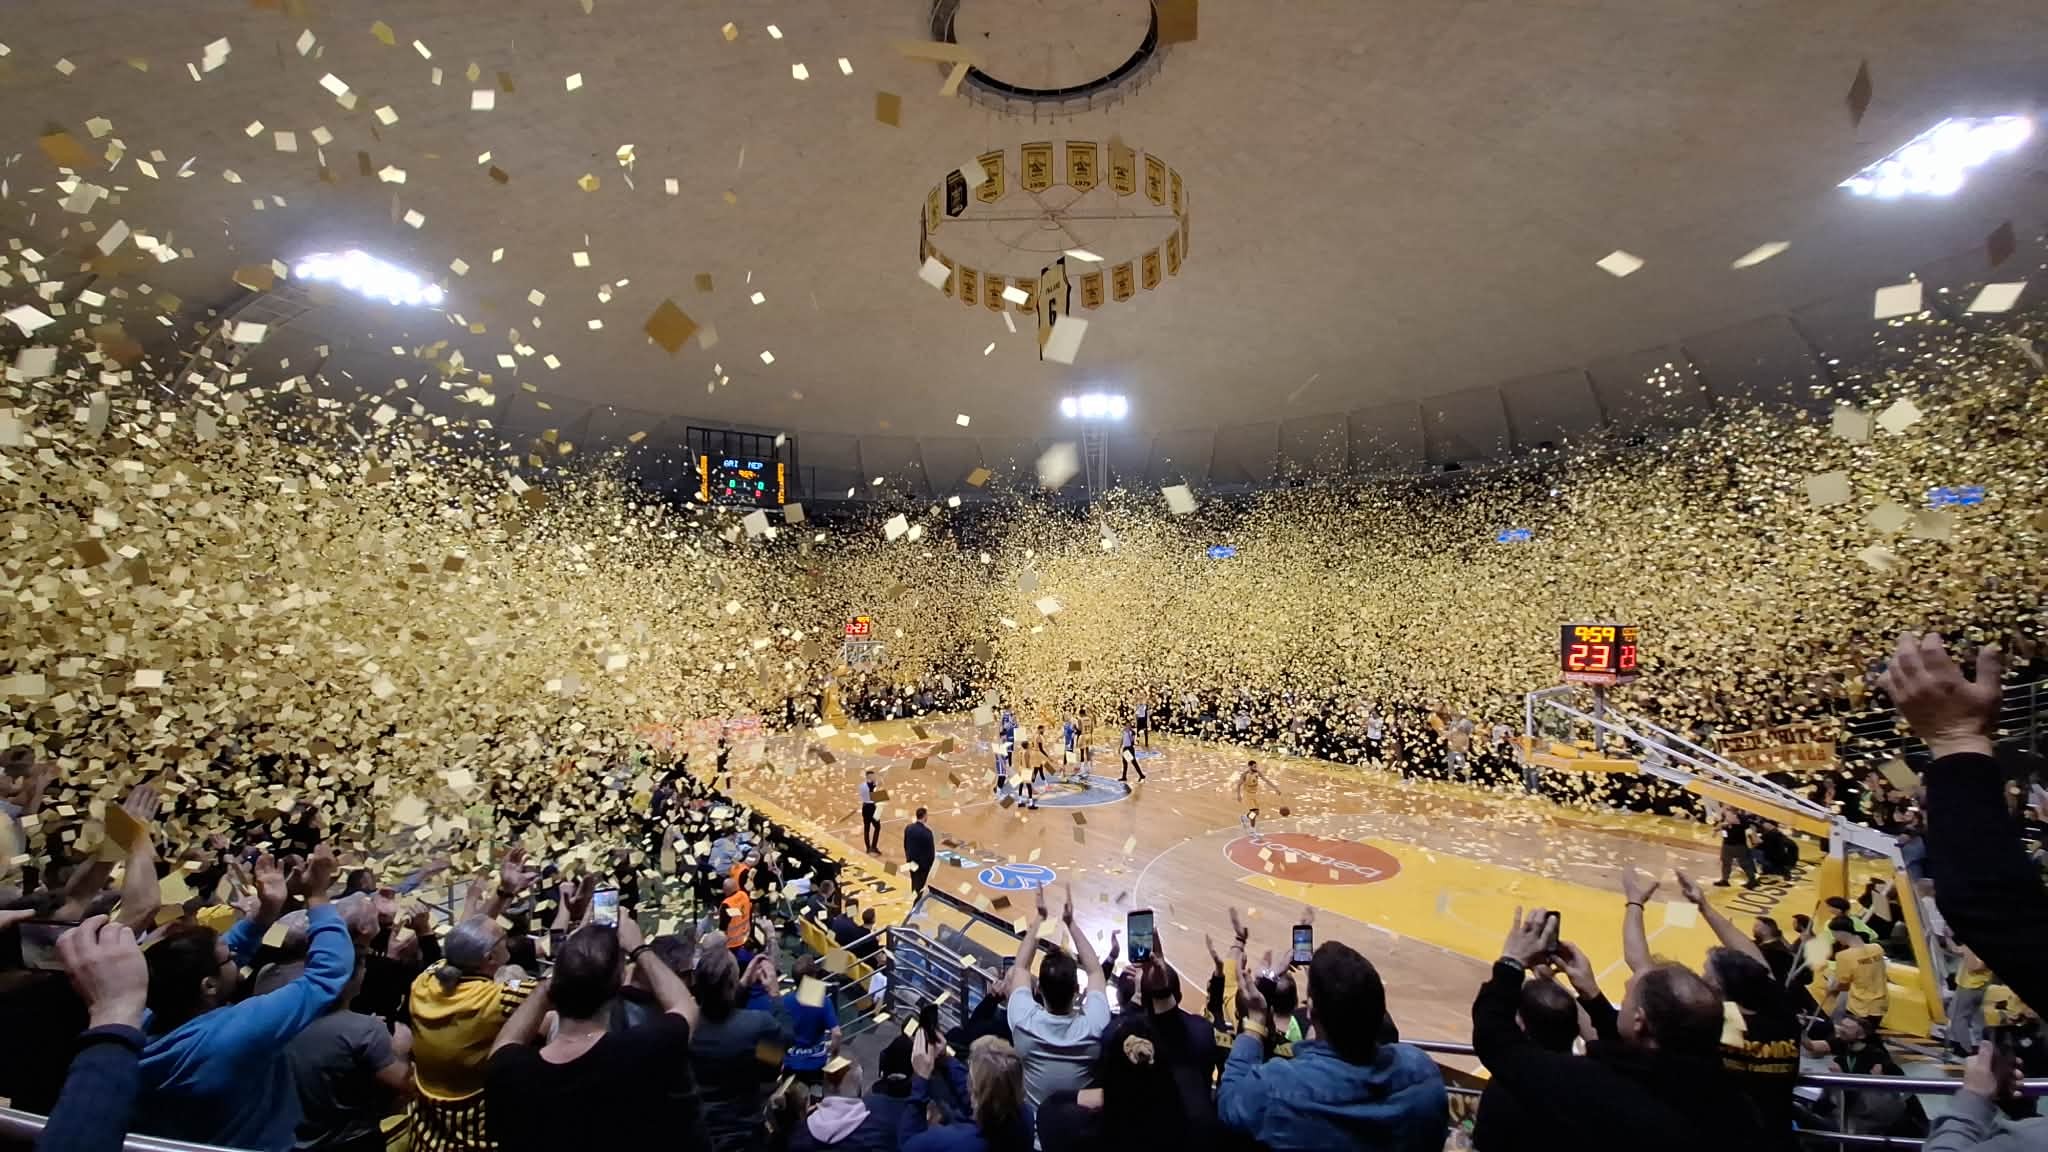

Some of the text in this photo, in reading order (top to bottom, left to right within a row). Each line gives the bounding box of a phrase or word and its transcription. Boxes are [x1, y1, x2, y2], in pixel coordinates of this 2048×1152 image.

[1049, 297, 1057, 327] 6
[854, 623, 868, 633] 23
[1568, 644, 1610, 668] 23
